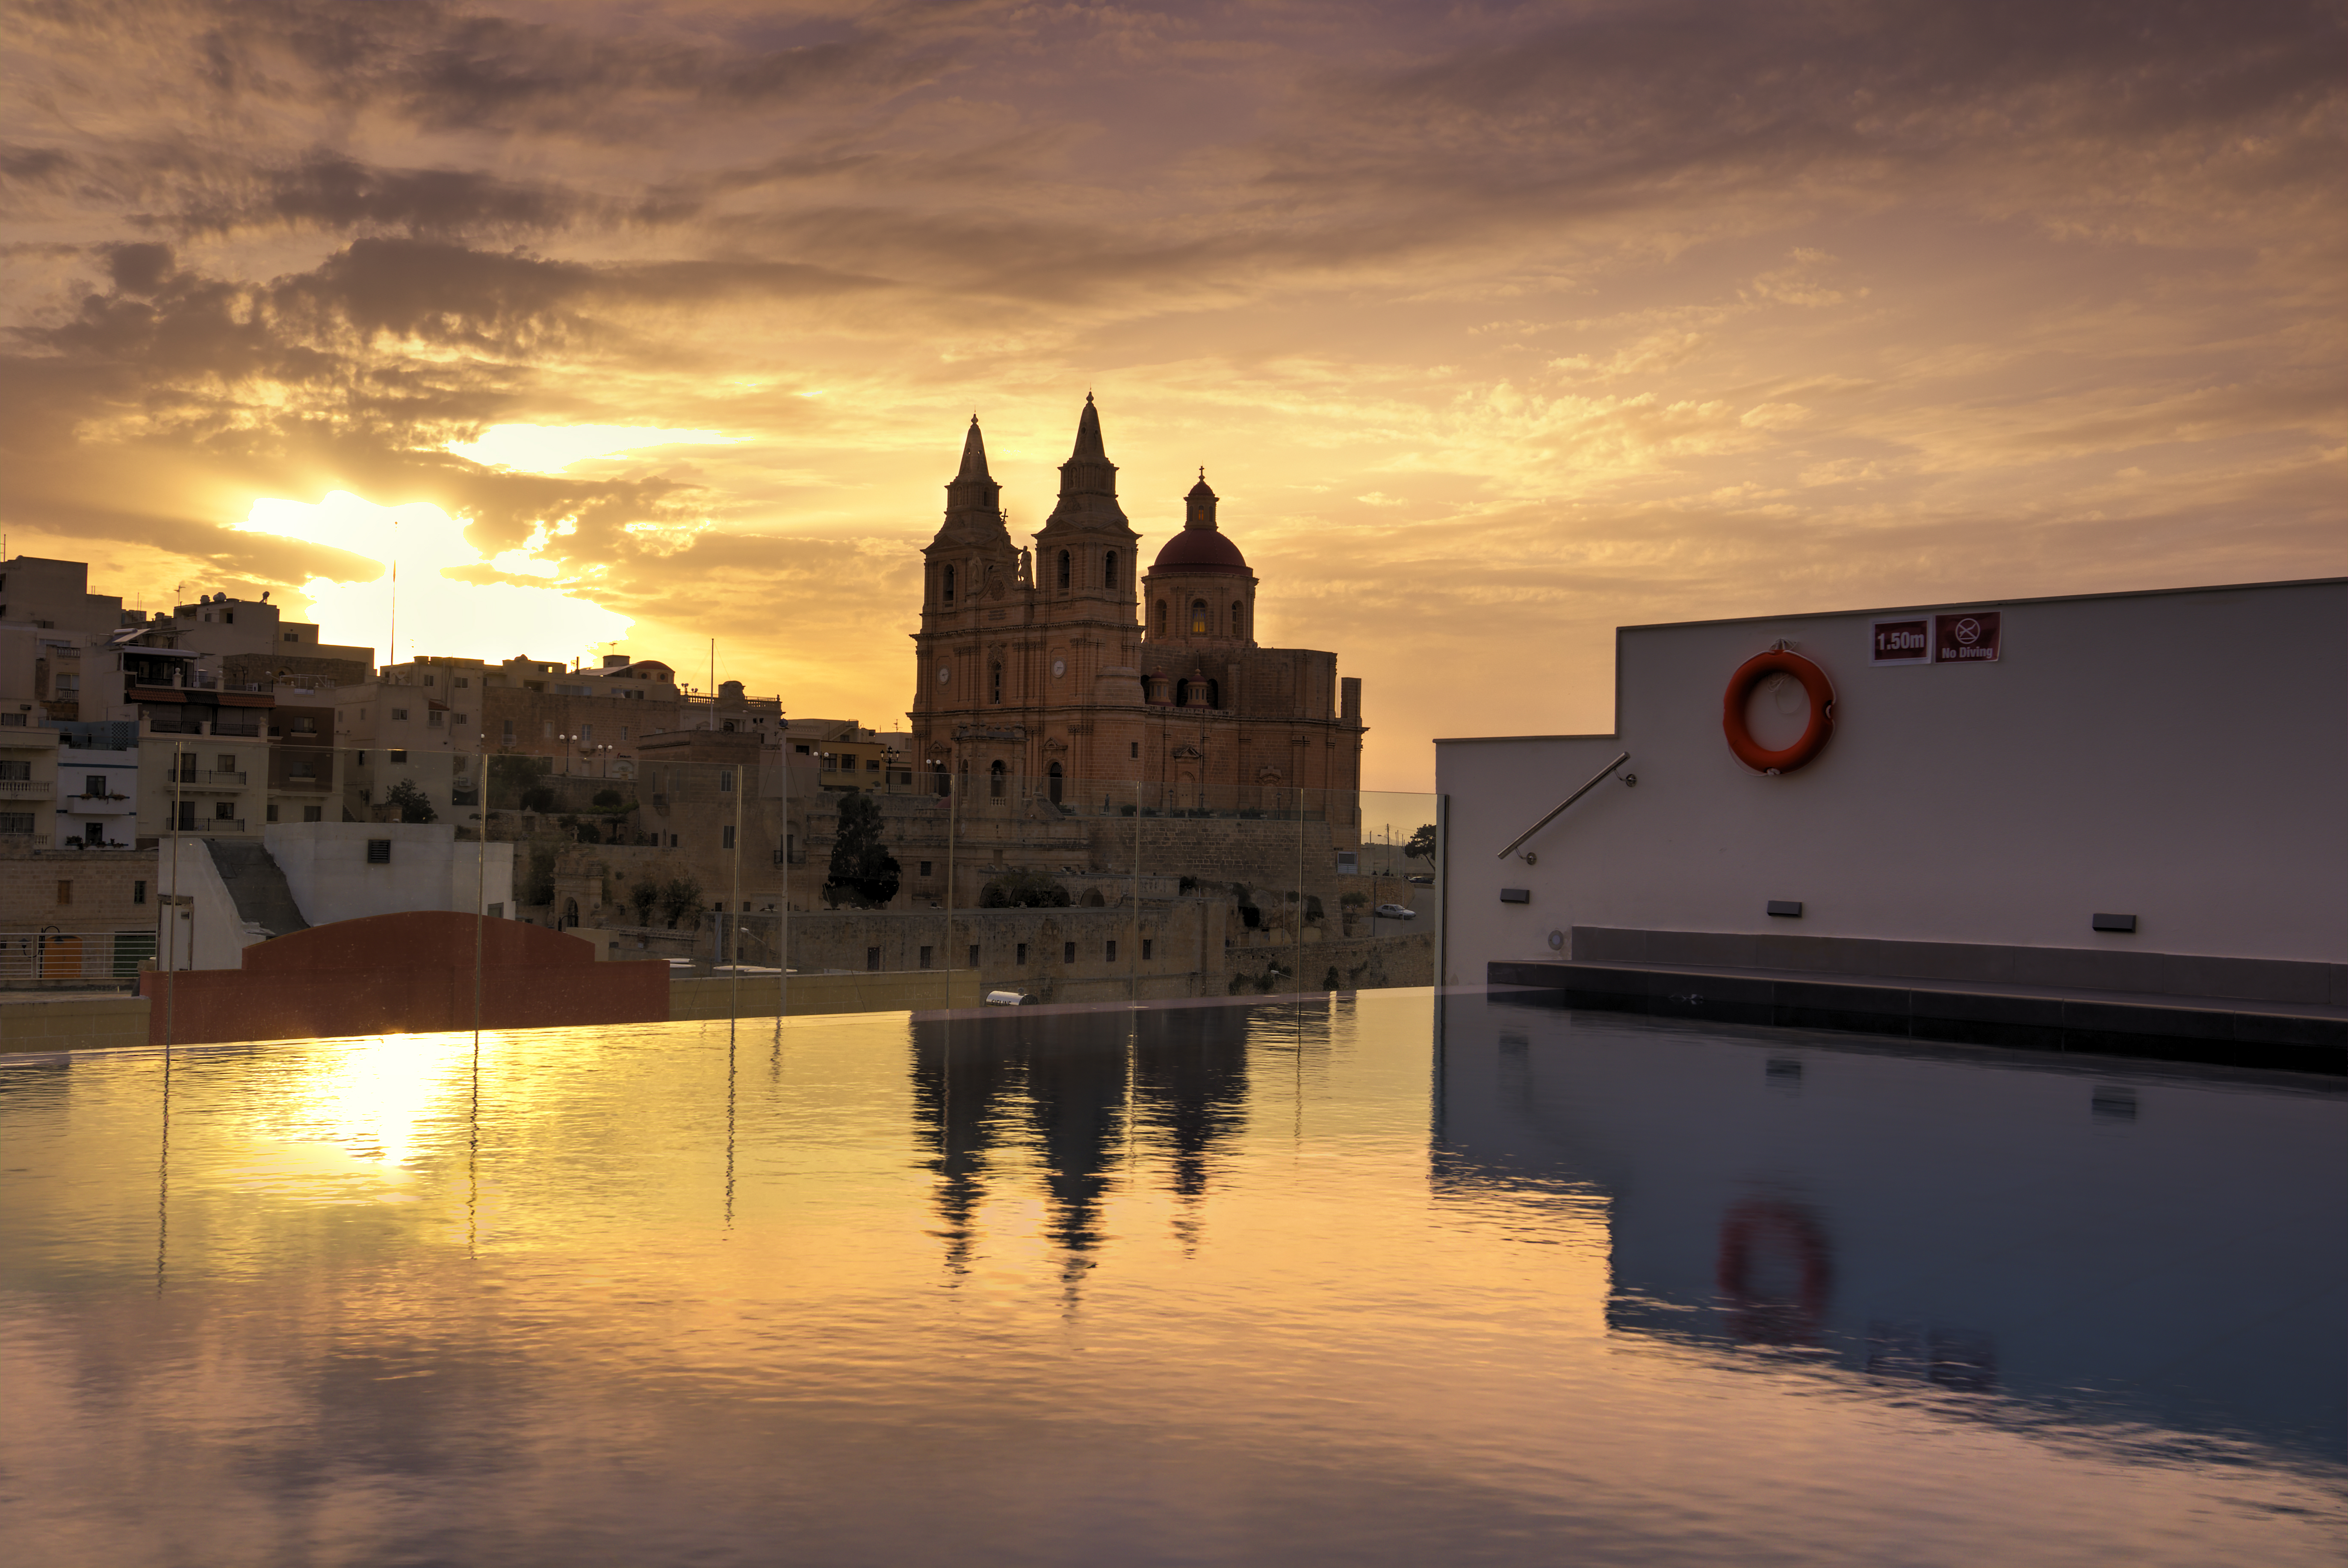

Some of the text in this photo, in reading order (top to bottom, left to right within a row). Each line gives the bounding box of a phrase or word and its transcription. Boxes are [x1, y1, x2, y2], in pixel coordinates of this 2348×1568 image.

[1878, 632, 1924, 650] 1.50m
[1942, 646, 1993, 659] No Diving
